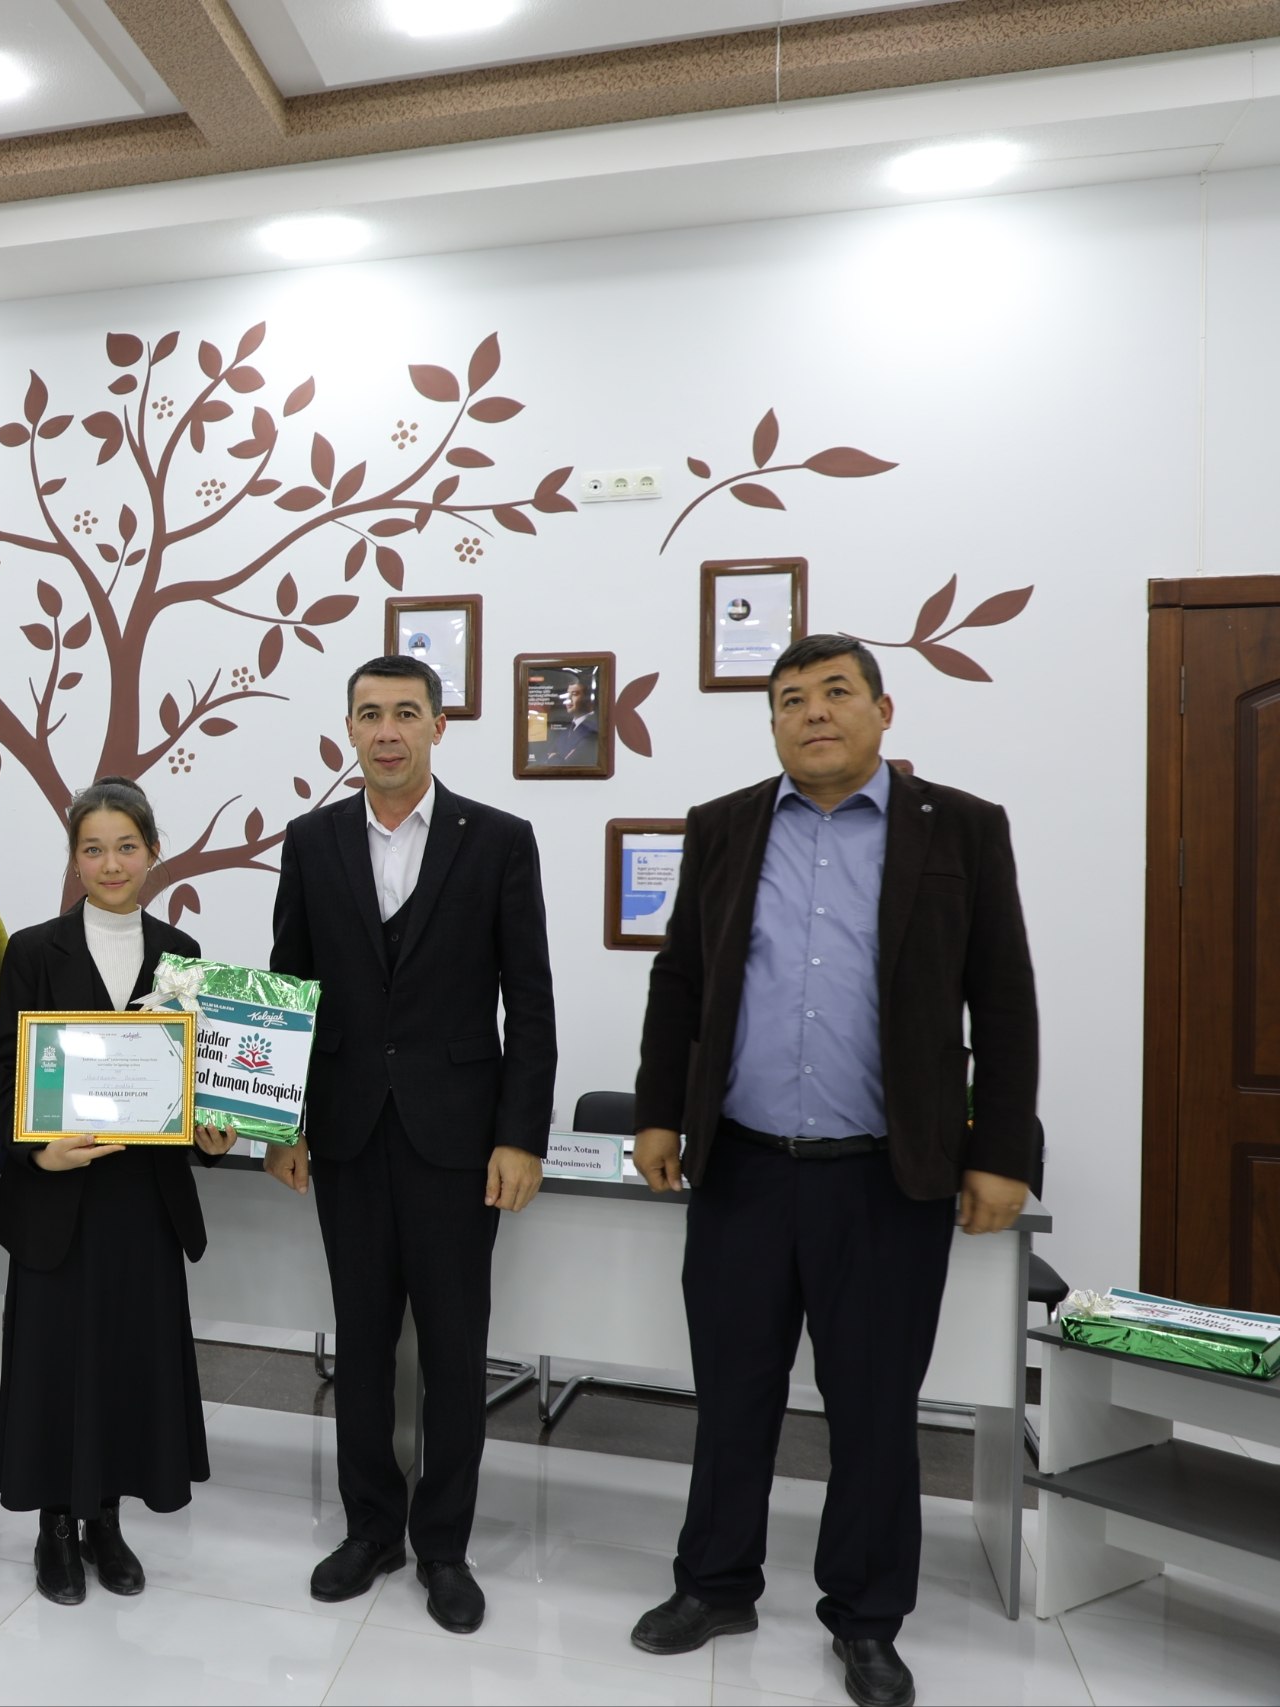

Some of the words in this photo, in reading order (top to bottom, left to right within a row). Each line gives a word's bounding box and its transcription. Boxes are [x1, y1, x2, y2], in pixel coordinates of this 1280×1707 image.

[247, 1010, 288, 1027] Kelajak
[213, 1071, 250, 1094] tuman
[252, 1077, 303, 1103] bosqichi
[574, 1146, 600, 1154] Xotam
